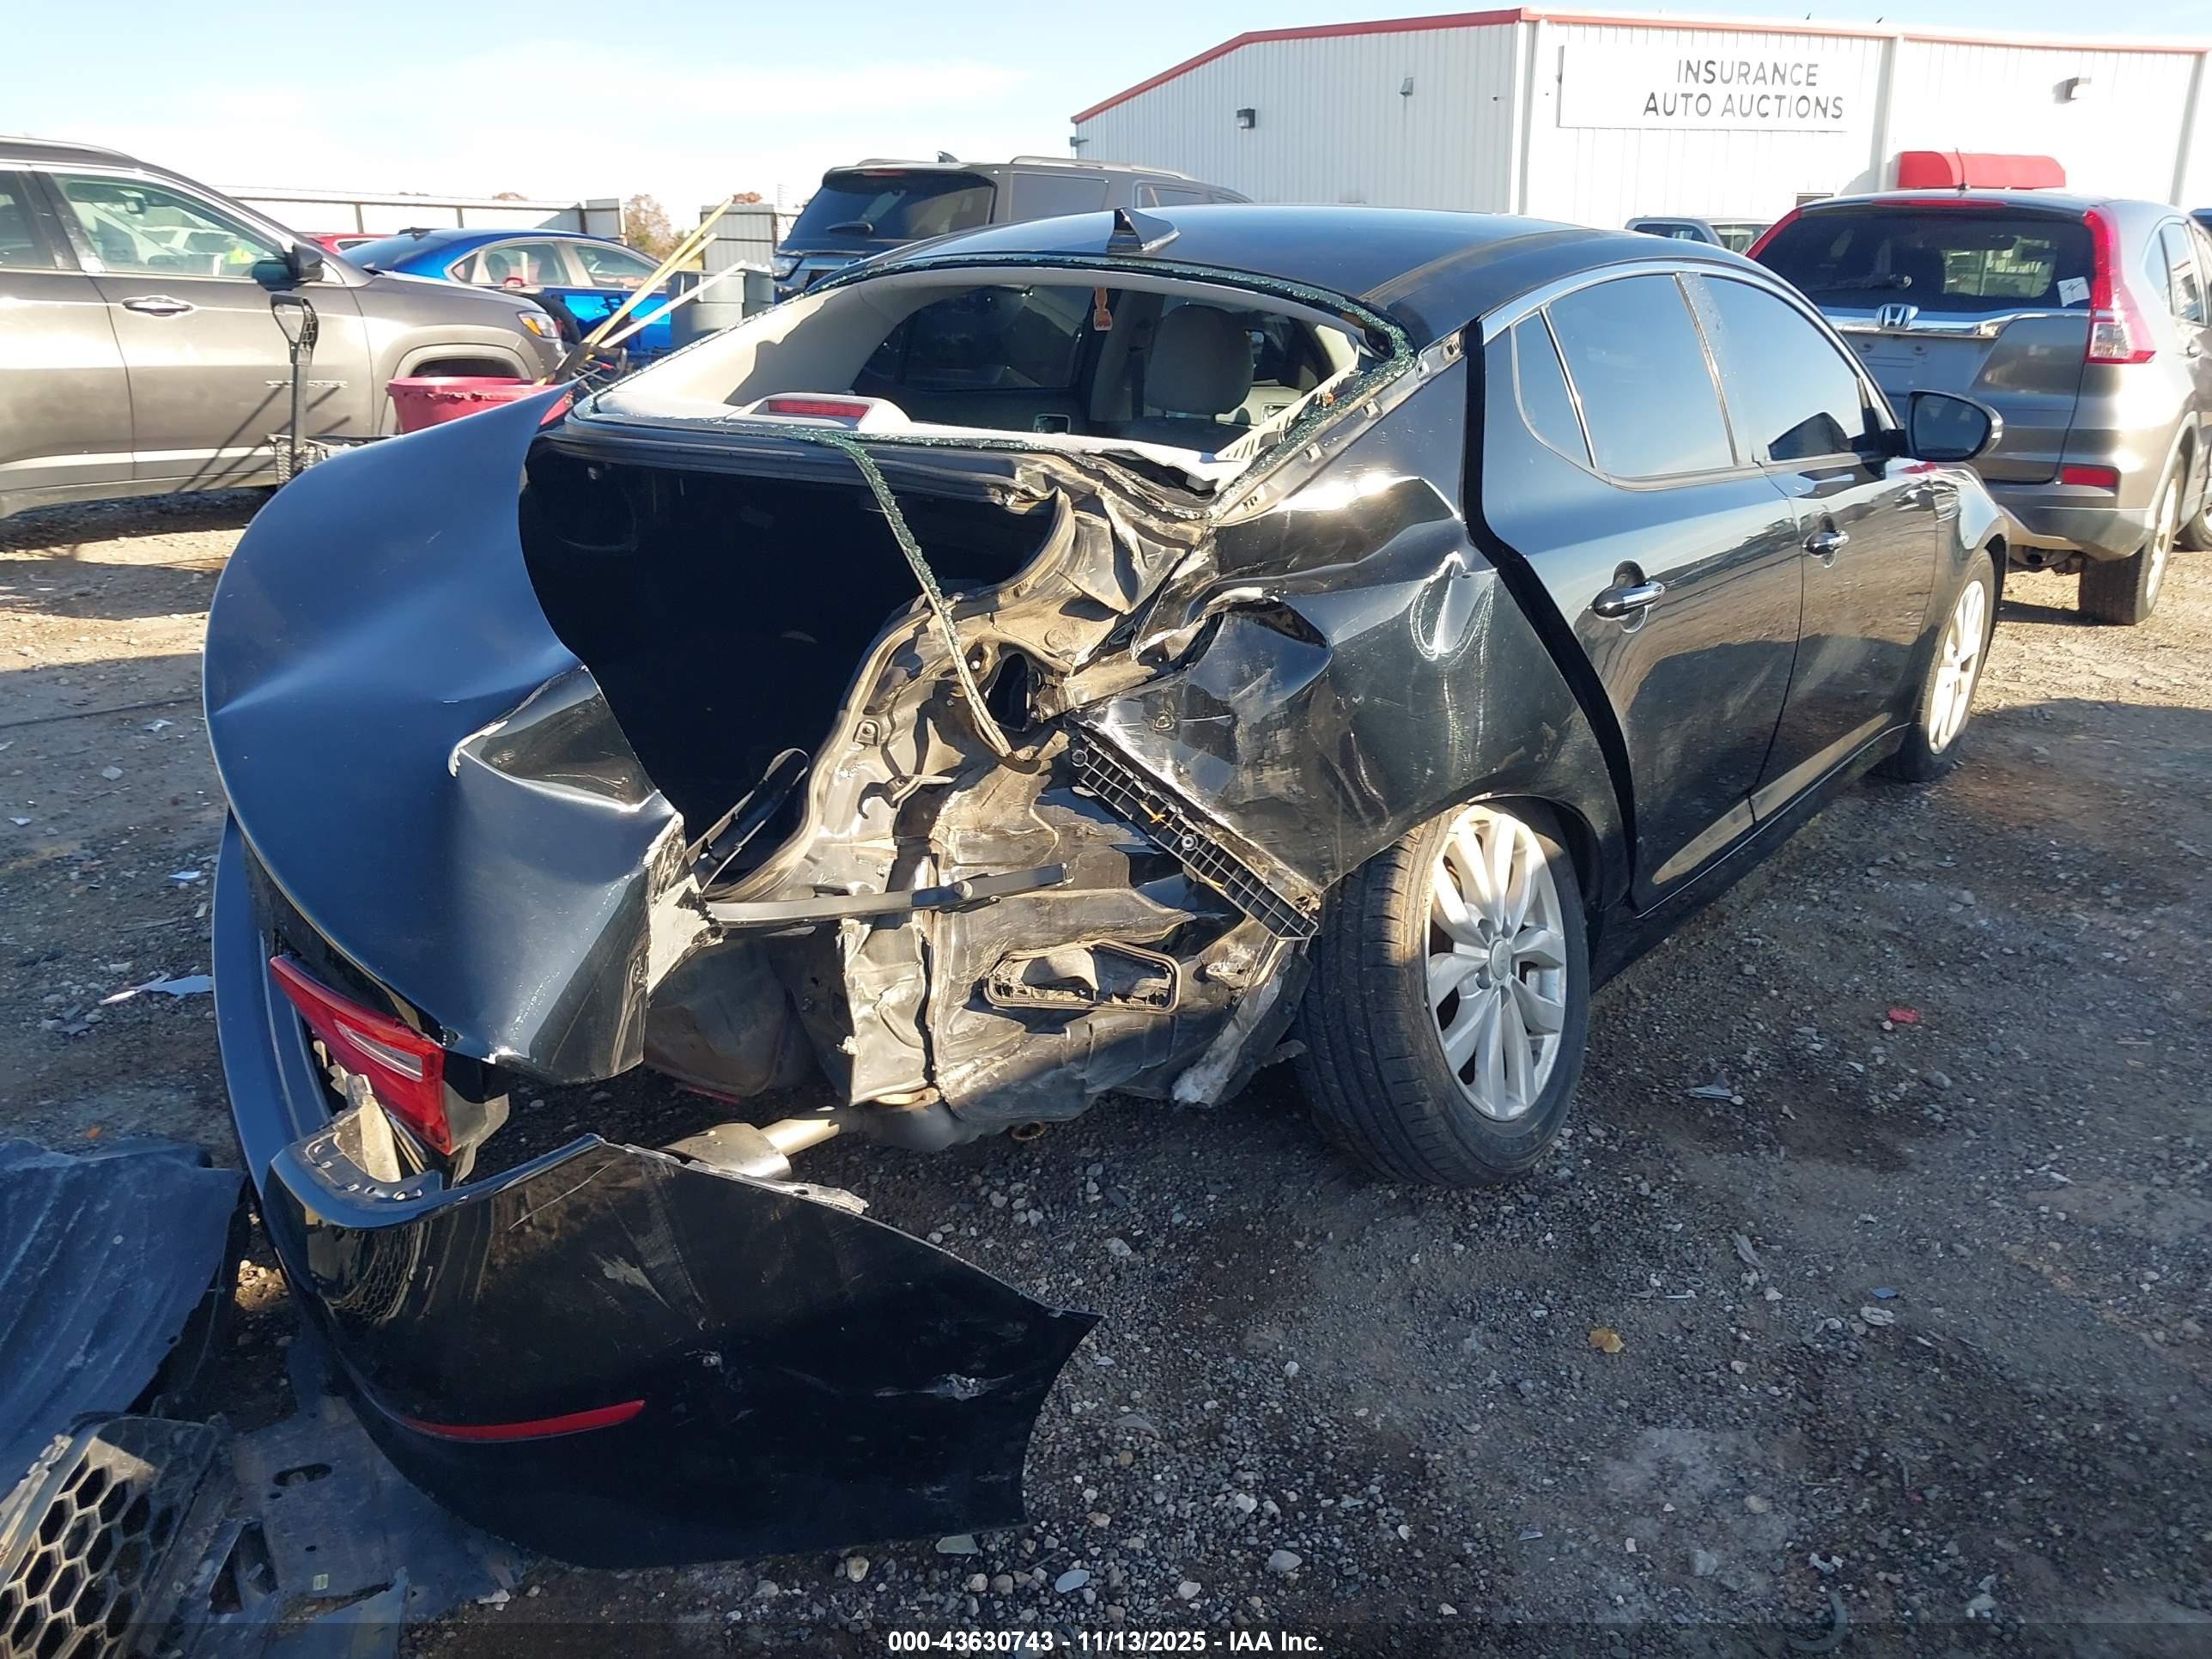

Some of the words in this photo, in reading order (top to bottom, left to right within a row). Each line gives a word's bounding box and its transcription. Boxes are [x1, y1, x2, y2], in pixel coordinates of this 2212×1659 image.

[1677, 59, 1819, 87] INSURANCE
[1643, 91, 1711, 117] AUTO
[1721, 93, 1844, 119] AUCTIONS
